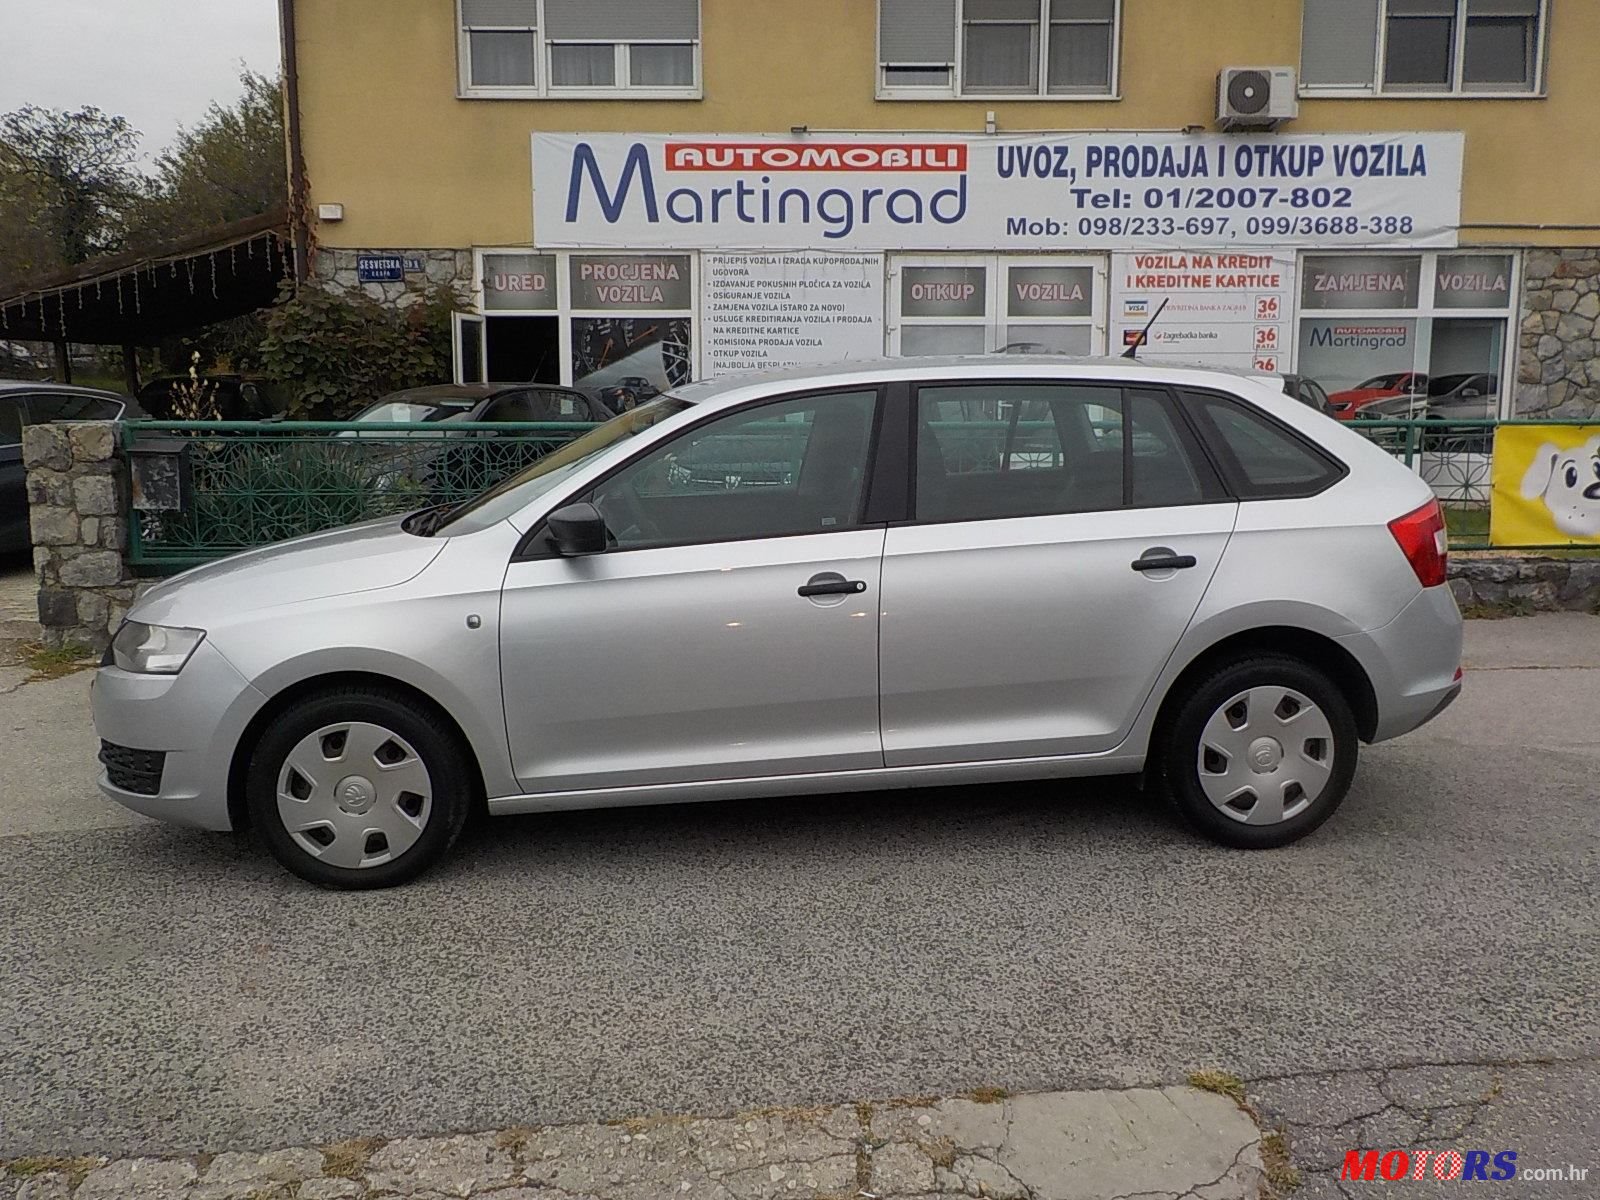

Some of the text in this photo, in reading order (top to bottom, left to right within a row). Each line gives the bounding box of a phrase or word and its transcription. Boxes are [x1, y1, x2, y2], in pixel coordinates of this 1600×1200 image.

[674, 147, 958, 168] AUTOMOBILI
[997, 144, 1427, 185] UVOZ, PRODAJA I OTKUP VOZILA
[564, 142, 968, 239] Martingrad
[1070, 187, 1352, 209] Tel: 01/2007-802
[1006, 216, 1413, 238] Mob: 098/233-697, 099/3688-388
[359, 260, 400, 269] SESVETSKA
[712, 256, 748, 264] PRIJEPIS
[750, 256, 776, 264] VOZILA
[1135, 256, 1274, 269] VOZILA NA KREDIT
[579, 263, 680, 281] PROCJENA
[494, 274, 546, 292] URED
[713, 280, 754, 288] IZDAVANJE
[799, 278, 830, 288] PLOČICA
[1126, 274, 1280, 288] I KREDITNE KARTICE
[1314, 273, 1506, 292] ZAMJENA VOZILA
[596, 285, 664, 303] VOZILA
[712, 292, 762, 300] OSIGURANJE
[911, 283, 975, 300] OTKUP
[1016, 283, 1084, 301] VOZILA
[1258, 297, 1278, 314] 36
[1198, 331, 1218, 339] banka
[1256, 328, 1276, 344] 36
[1309, 327, 1407, 350] Martingrad
[1255, 358, 1274, 372] 36
